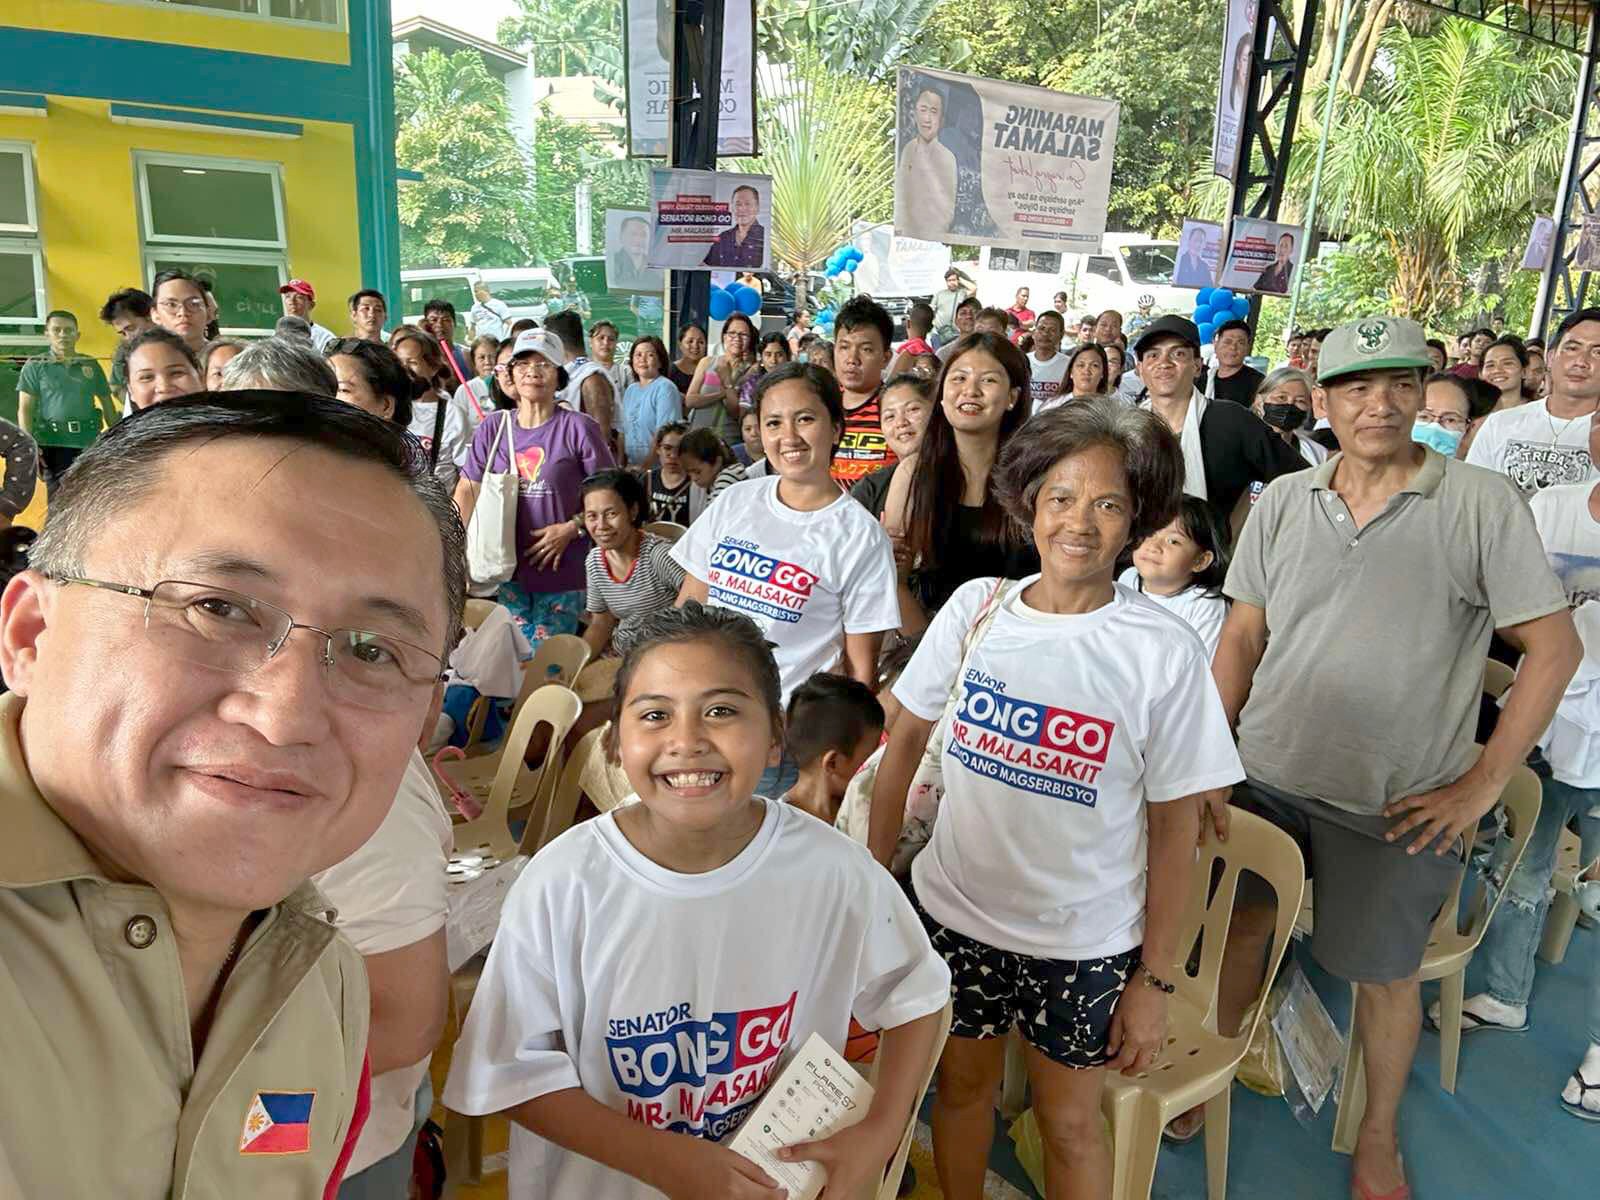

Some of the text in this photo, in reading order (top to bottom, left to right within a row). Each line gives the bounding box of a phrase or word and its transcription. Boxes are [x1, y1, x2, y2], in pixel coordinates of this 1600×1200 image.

[660, 214, 731, 223] SENATOR BONG GO
[1031, 383, 1058, 391] NG GO
[840, 434, 886, 448] RP
[1522, 451, 1570, 470] TRIBAL
[721, 535, 760, 552] SENATOR
[711, 547, 814, 591] BONG GO
[720, 591, 738, 604] ANG
[739, 597, 800, 622] MAGSERBISYO
[725, 575, 808, 609] MALASAKIT
[953, 685, 1107, 755] BONG GO
[976, 732, 1103, 785] MALASAKIT
[970, 757, 1095, 804] ANG MAGSERBISYO
[608, 1002, 692, 1037] SENATOR
[612, 1007, 791, 1087] BONG GO
[806, 1060, 843, 1100] FLARE
[841, 1095, 857, 1111] S7
[627, 1097, 672, 1126] MR.
